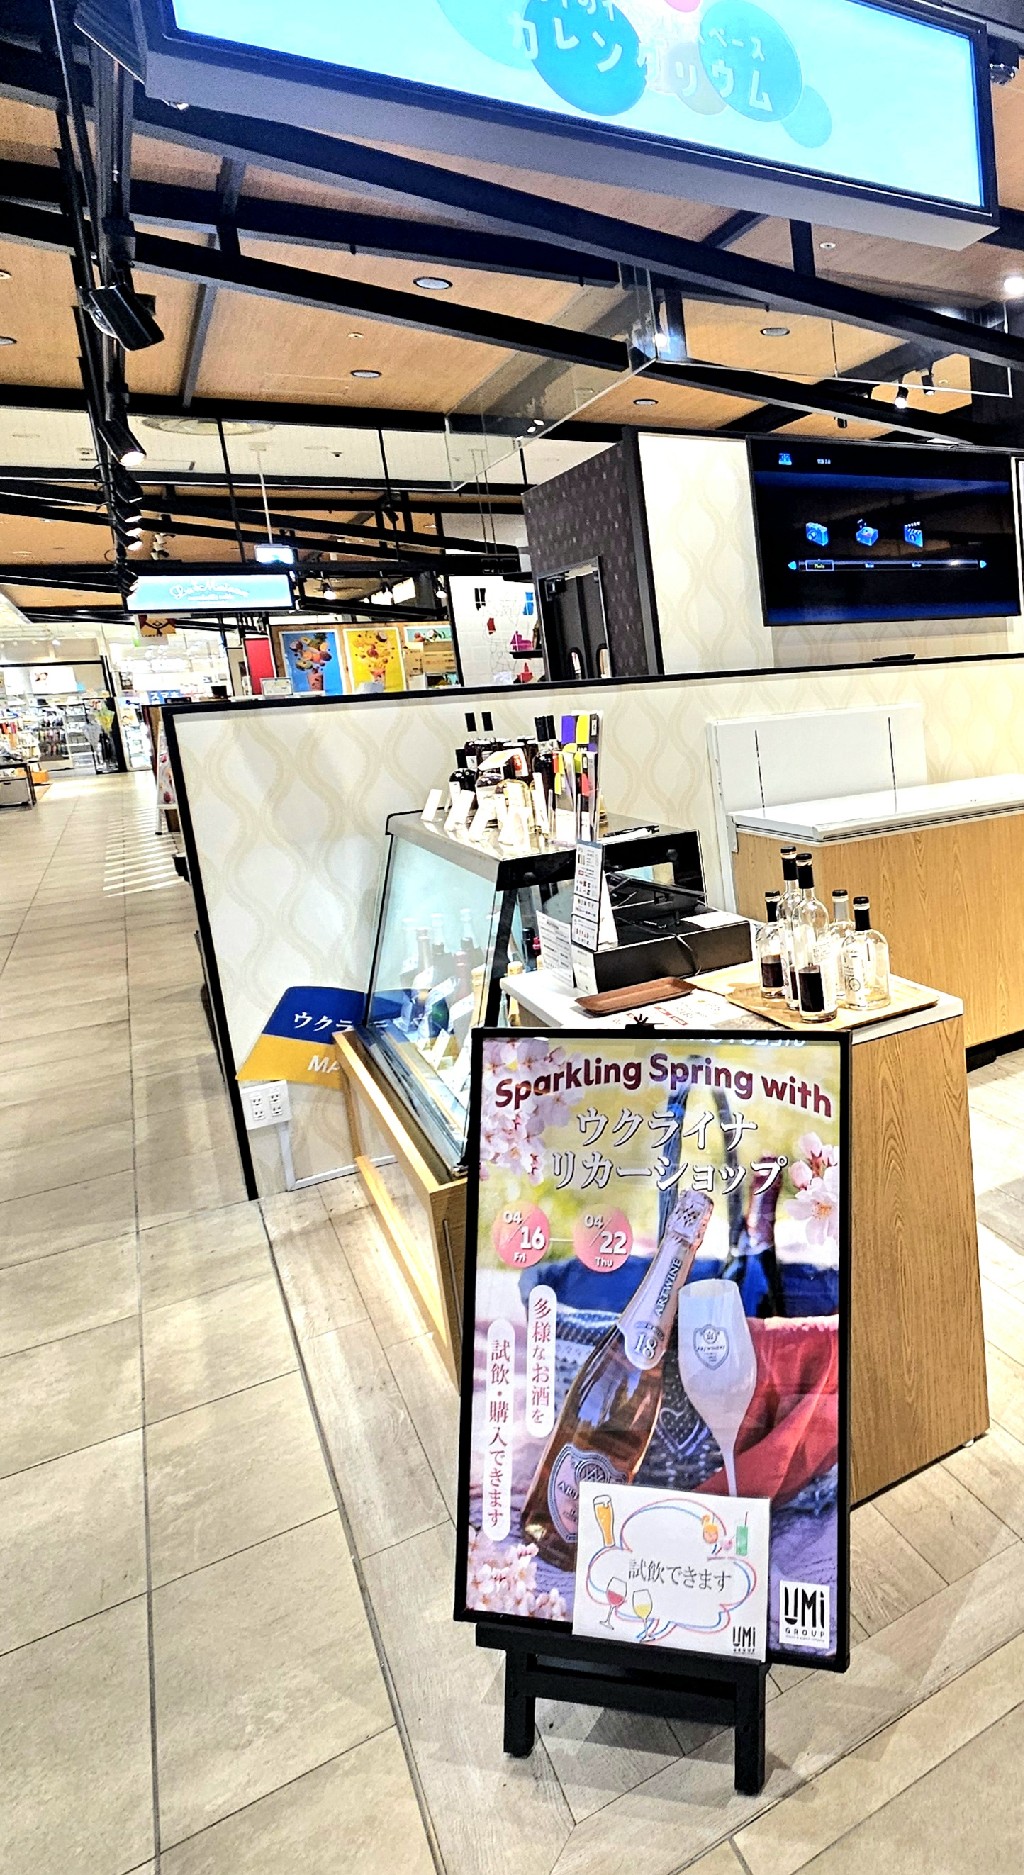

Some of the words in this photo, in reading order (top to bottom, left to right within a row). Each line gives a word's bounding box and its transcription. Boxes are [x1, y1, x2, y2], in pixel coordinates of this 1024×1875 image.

[495, 1057, 642, 1110] Sparkling
[649, 1053, 754, 1100] Spring
[761, 1075, 832, 1118] with
[577, 1106, 758, 1151] ウクライナ
[552, 1151, 788, 1195] リカーショップ
[595, 1257, 613, 1268] Thu
[531, 1297, 552, 1424] 多様なお酒を
[487, 1339, 511, 1527] 試飲・購入できます
[628, 1558, 733, 1592] 試飲できます
